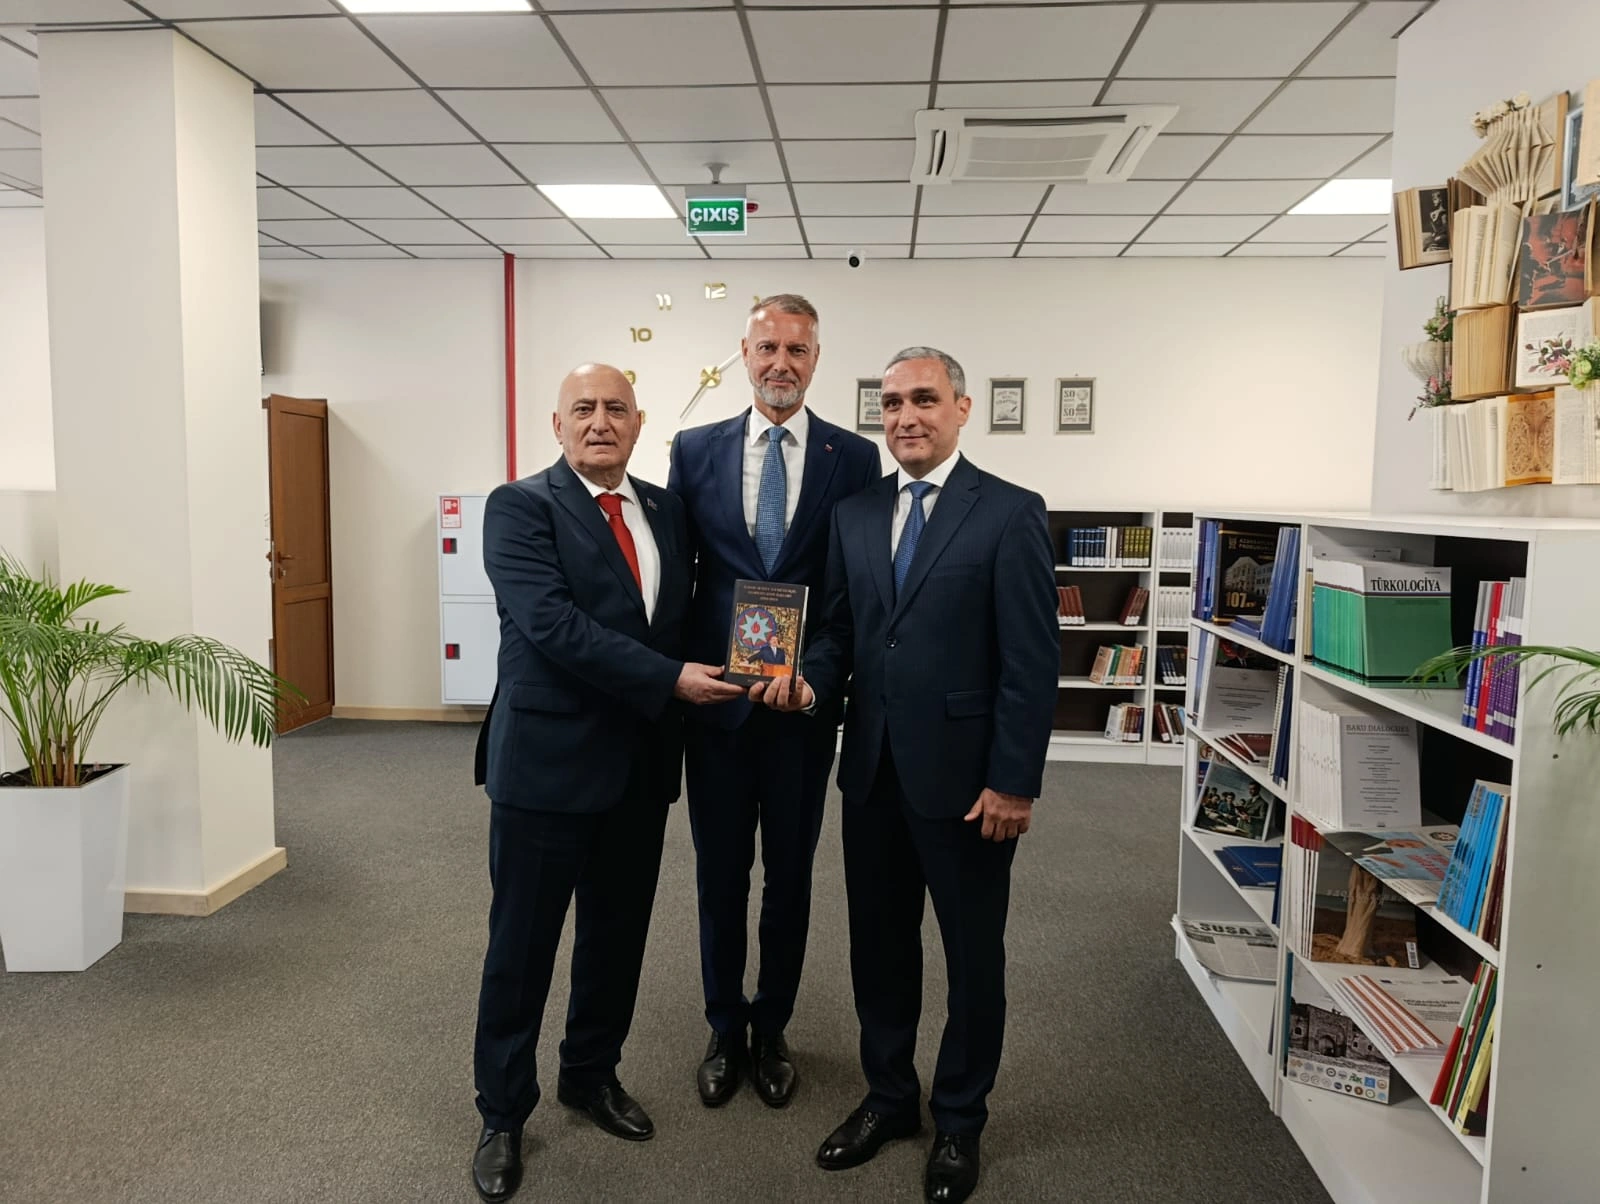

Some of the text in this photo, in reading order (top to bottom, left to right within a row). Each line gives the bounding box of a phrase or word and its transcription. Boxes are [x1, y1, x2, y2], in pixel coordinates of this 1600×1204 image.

[690, 207, 740, 225] ÇIXIŞ
[704, 283, 727, 299] 12
[656, 293, 672, 311] 11
[630, 327, 653, 343] 10
[1371, 577, 1441, 592] TÜRKOLOGİYA
[1226, 591, 1248, 608] 107
